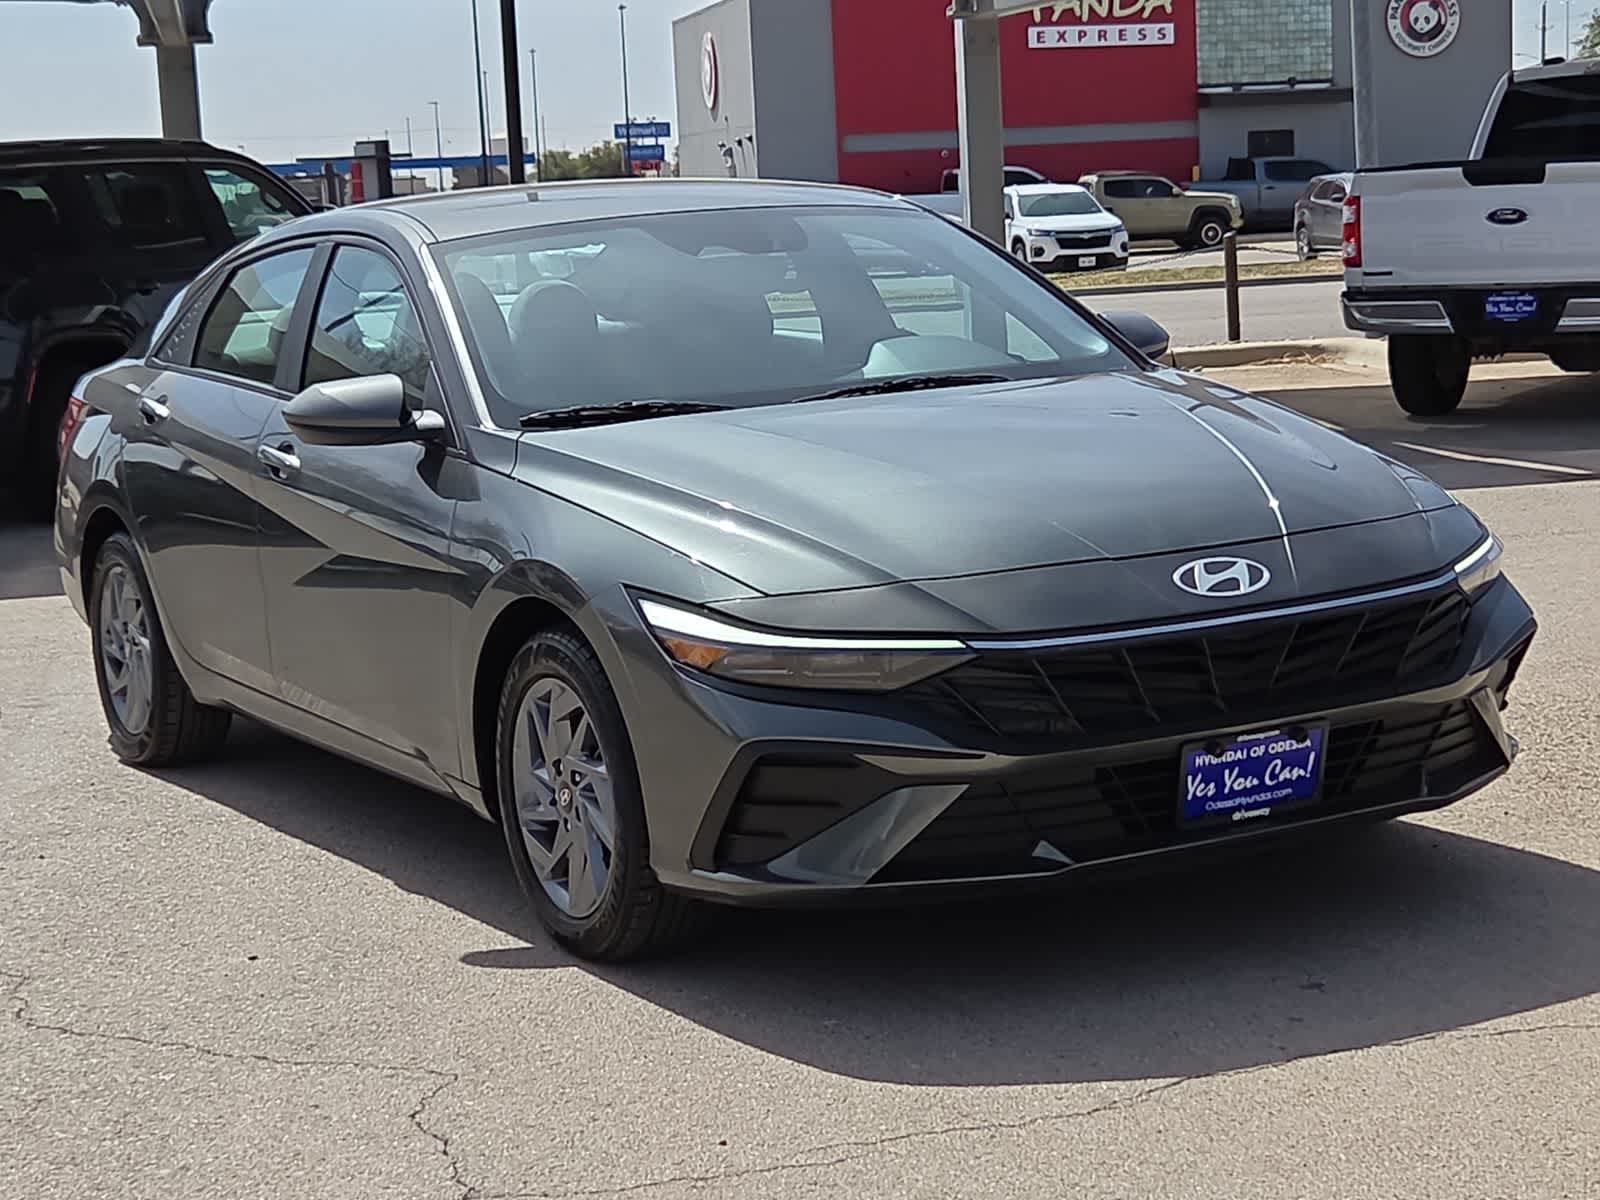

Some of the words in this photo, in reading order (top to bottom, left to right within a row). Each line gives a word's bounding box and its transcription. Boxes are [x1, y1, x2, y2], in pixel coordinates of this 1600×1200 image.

[1036, 27, 1167, 44] EXPRESS
[1250, 745, 1266, 758] OF
[1187, 773, 1216, 801] Yes
[1224, 766, 1259, 795] You
[1264, 751, 1316, 786] Can!
